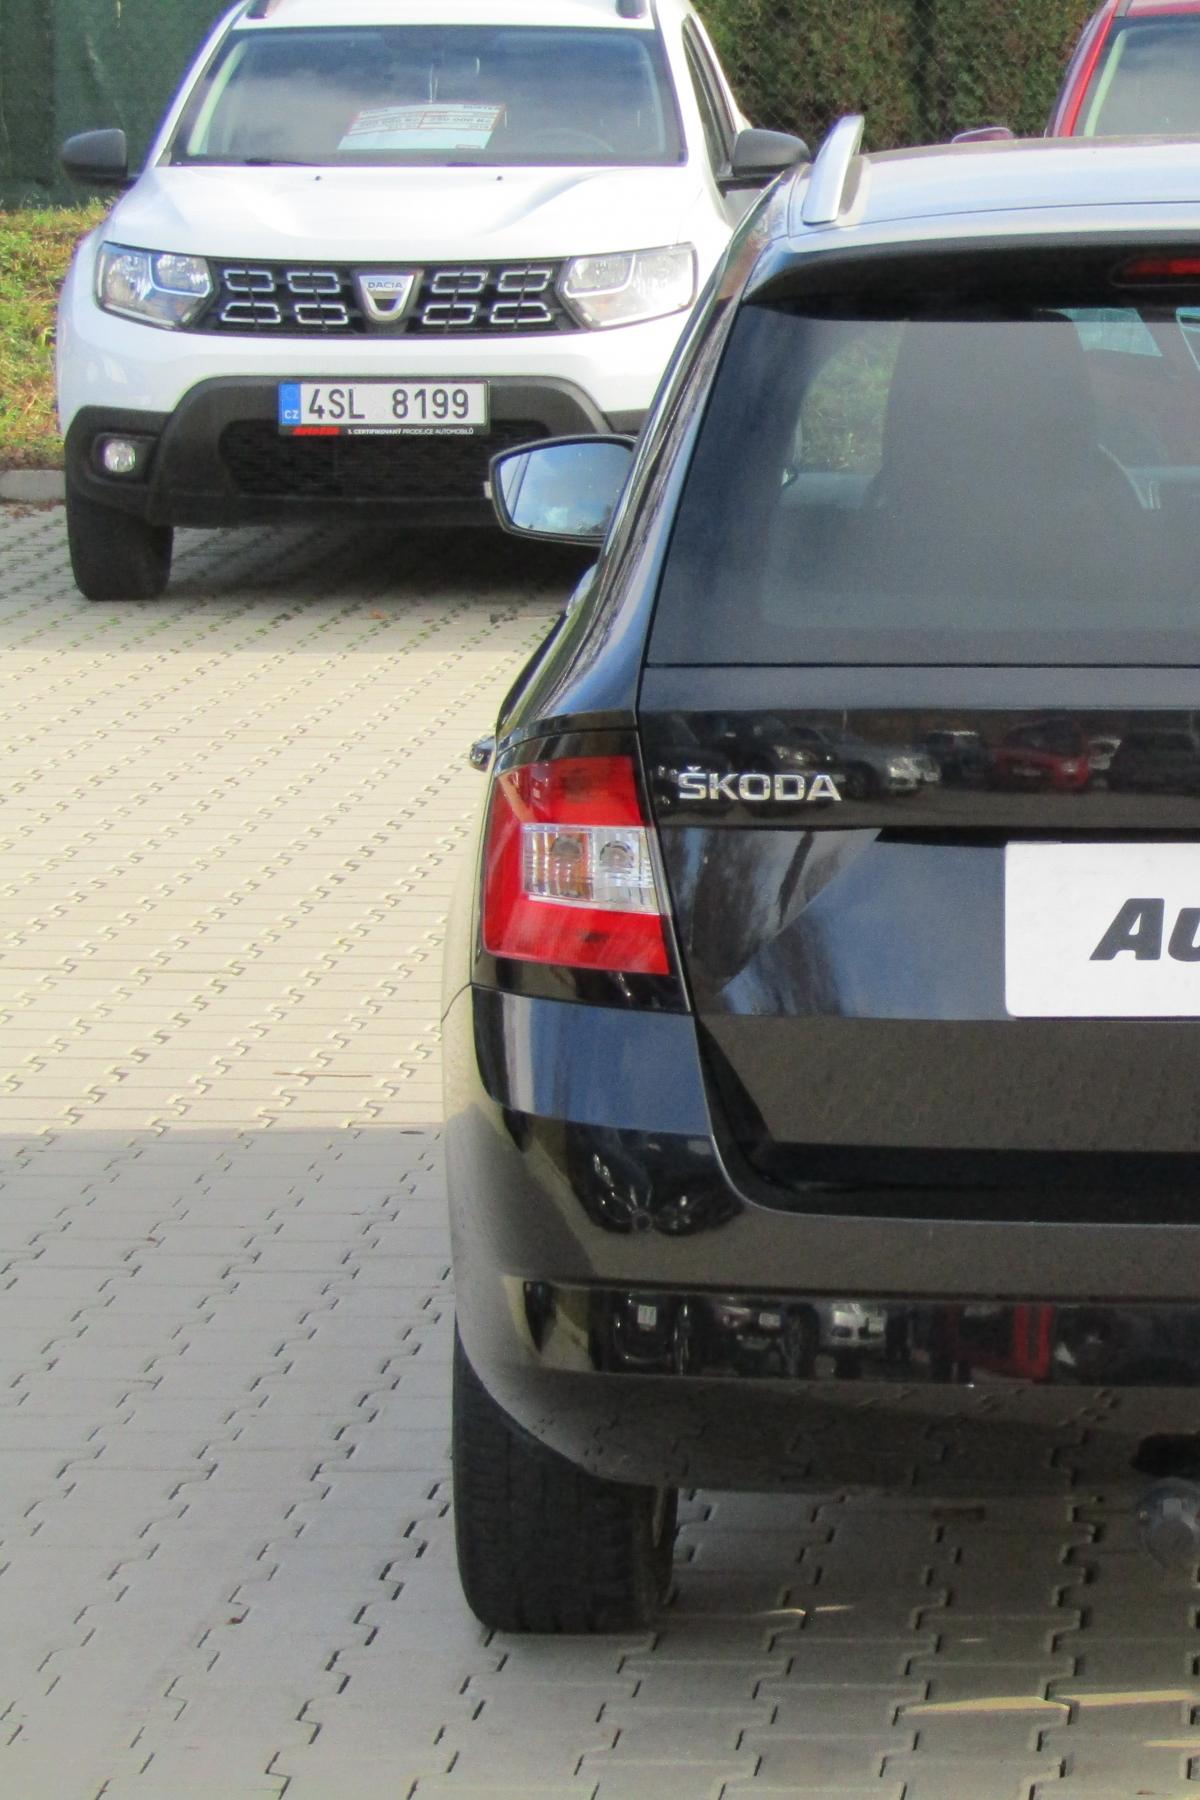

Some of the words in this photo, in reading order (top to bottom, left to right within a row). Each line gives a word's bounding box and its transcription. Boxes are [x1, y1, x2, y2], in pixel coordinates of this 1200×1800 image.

[367, 281, 402, 289] DACIA
[284, 409, 300, 420] CZ
[308, 388, 366, 420] 4SL
[392, 388, 470, 420] 8199
[677, 766, 843, 802] ŠKODA
